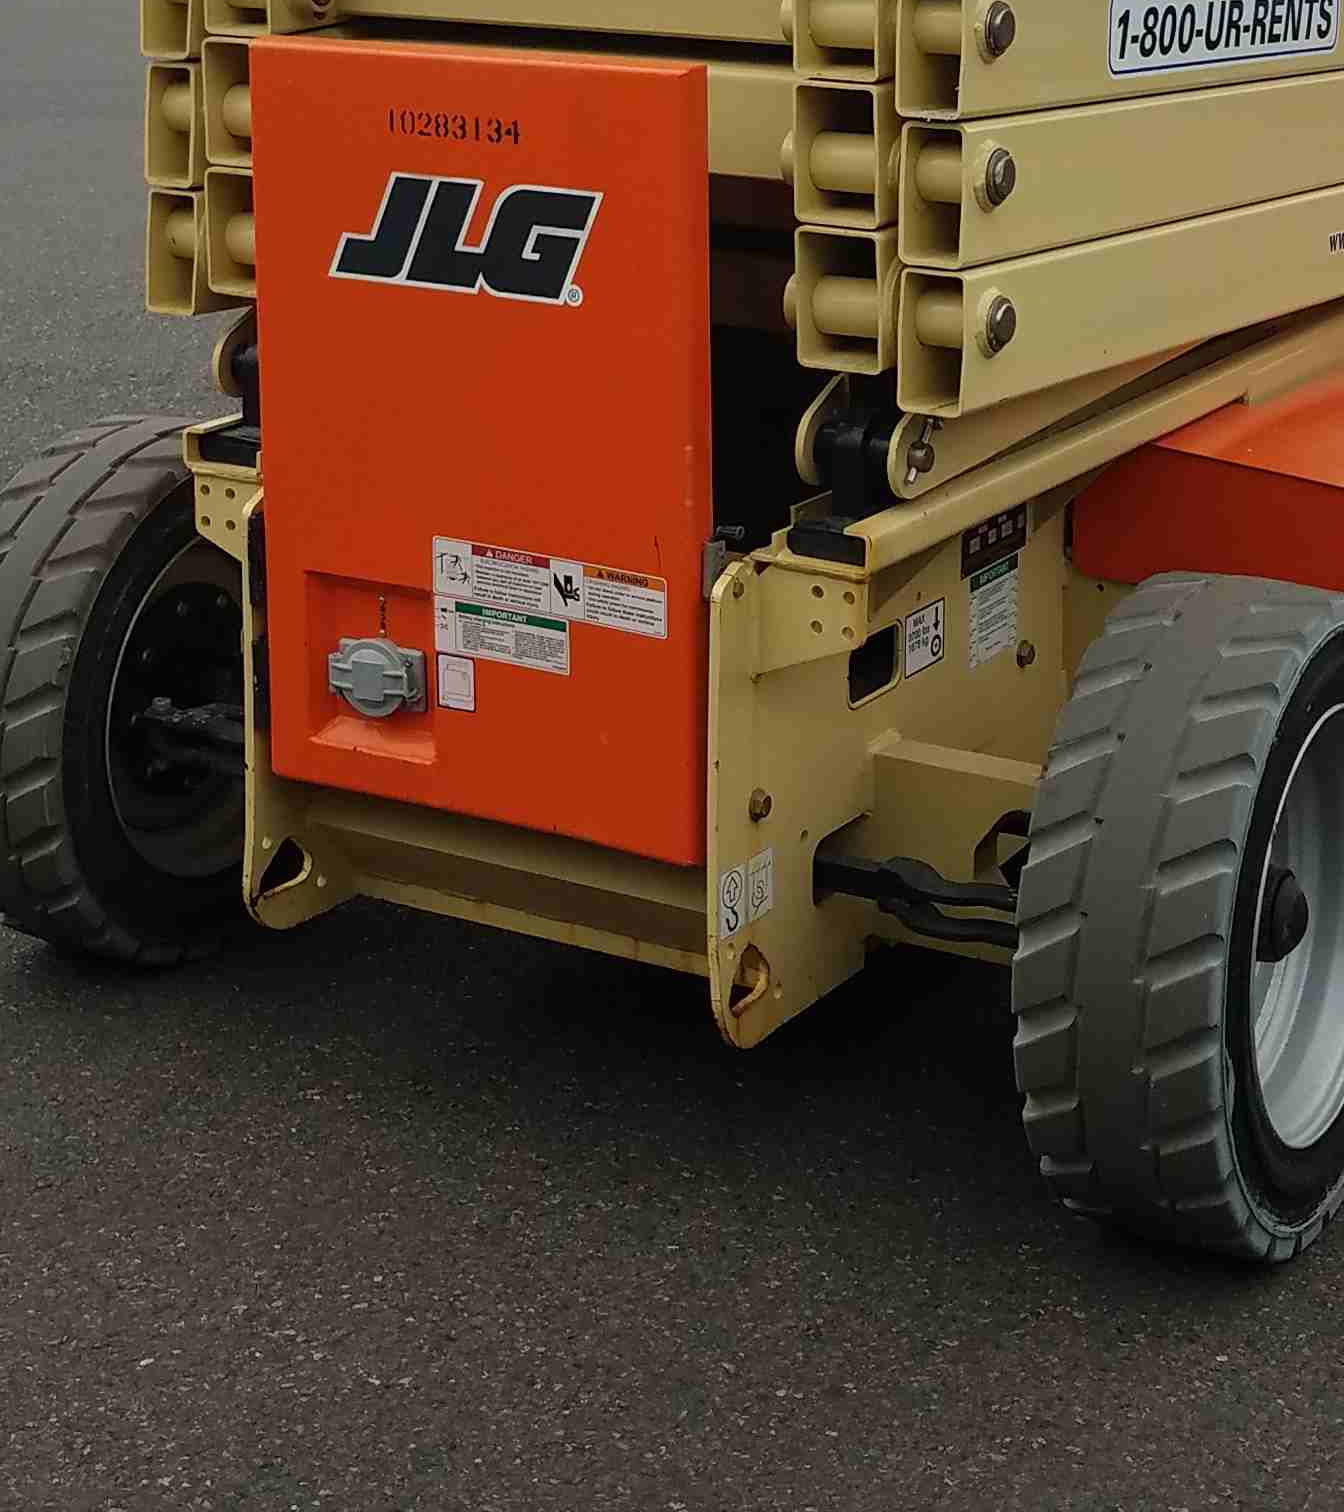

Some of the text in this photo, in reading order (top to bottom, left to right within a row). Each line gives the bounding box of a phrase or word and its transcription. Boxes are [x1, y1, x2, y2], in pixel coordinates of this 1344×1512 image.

[387, 108, 521, 145] 10283134
[328, 171, 604, 306] JLG
[495, 548, 534, 565] DANGER
[607, 571, 649, 588] WARNING
[481, 607, 529, 623] IMPORTANT
